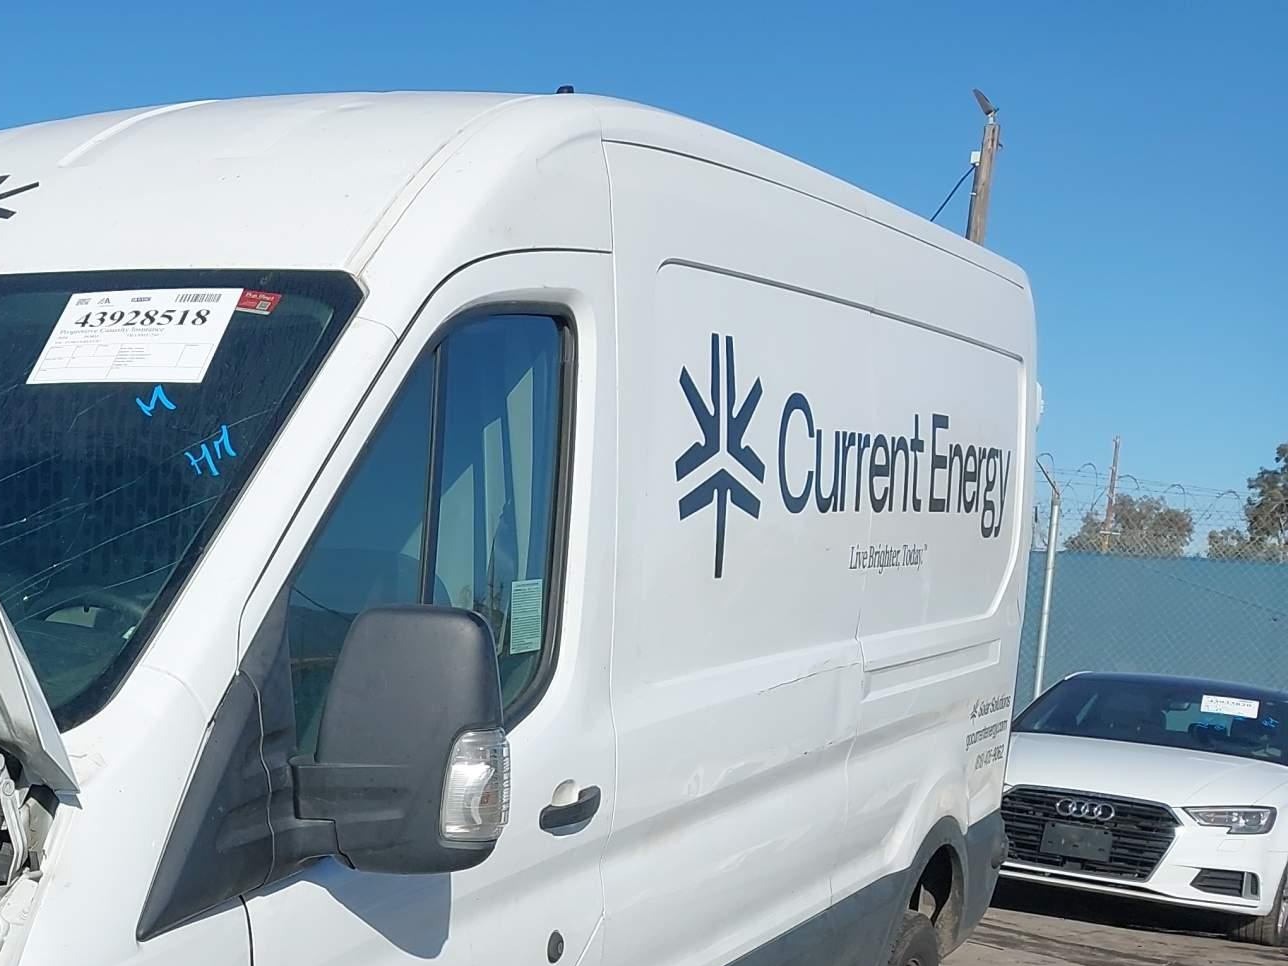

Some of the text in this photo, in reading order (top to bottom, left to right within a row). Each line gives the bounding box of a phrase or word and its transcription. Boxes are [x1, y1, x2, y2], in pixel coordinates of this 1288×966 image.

[73, 308, 211, 328] 43928518
[778, 392, 1012, 538] Current Energy
[848, 544, 868, 570] Live
[868, 544, 900, 575] Brighter,
[990, 696, 1011, 713] Solutions
